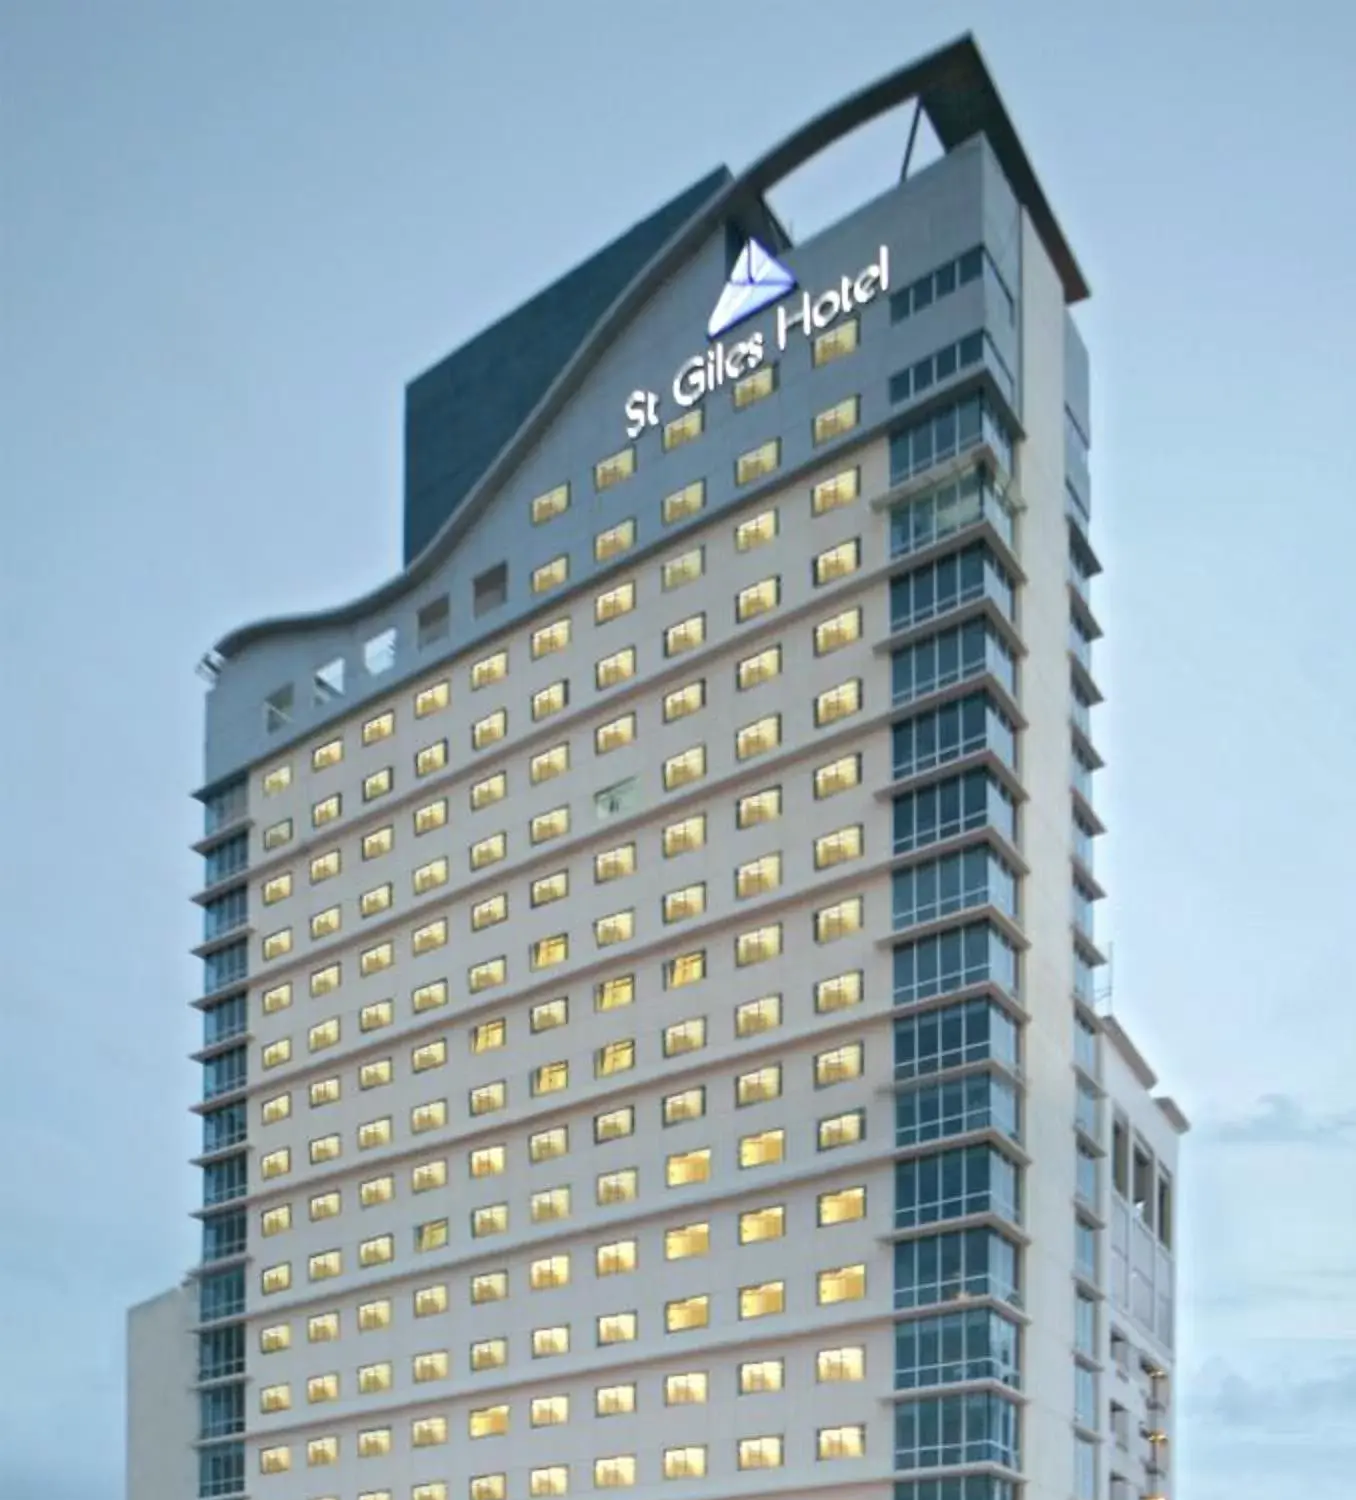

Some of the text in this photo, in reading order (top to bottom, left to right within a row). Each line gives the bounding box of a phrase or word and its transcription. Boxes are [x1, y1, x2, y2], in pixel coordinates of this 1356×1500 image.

[625, 244, 889, 438] St Giles Hotel
